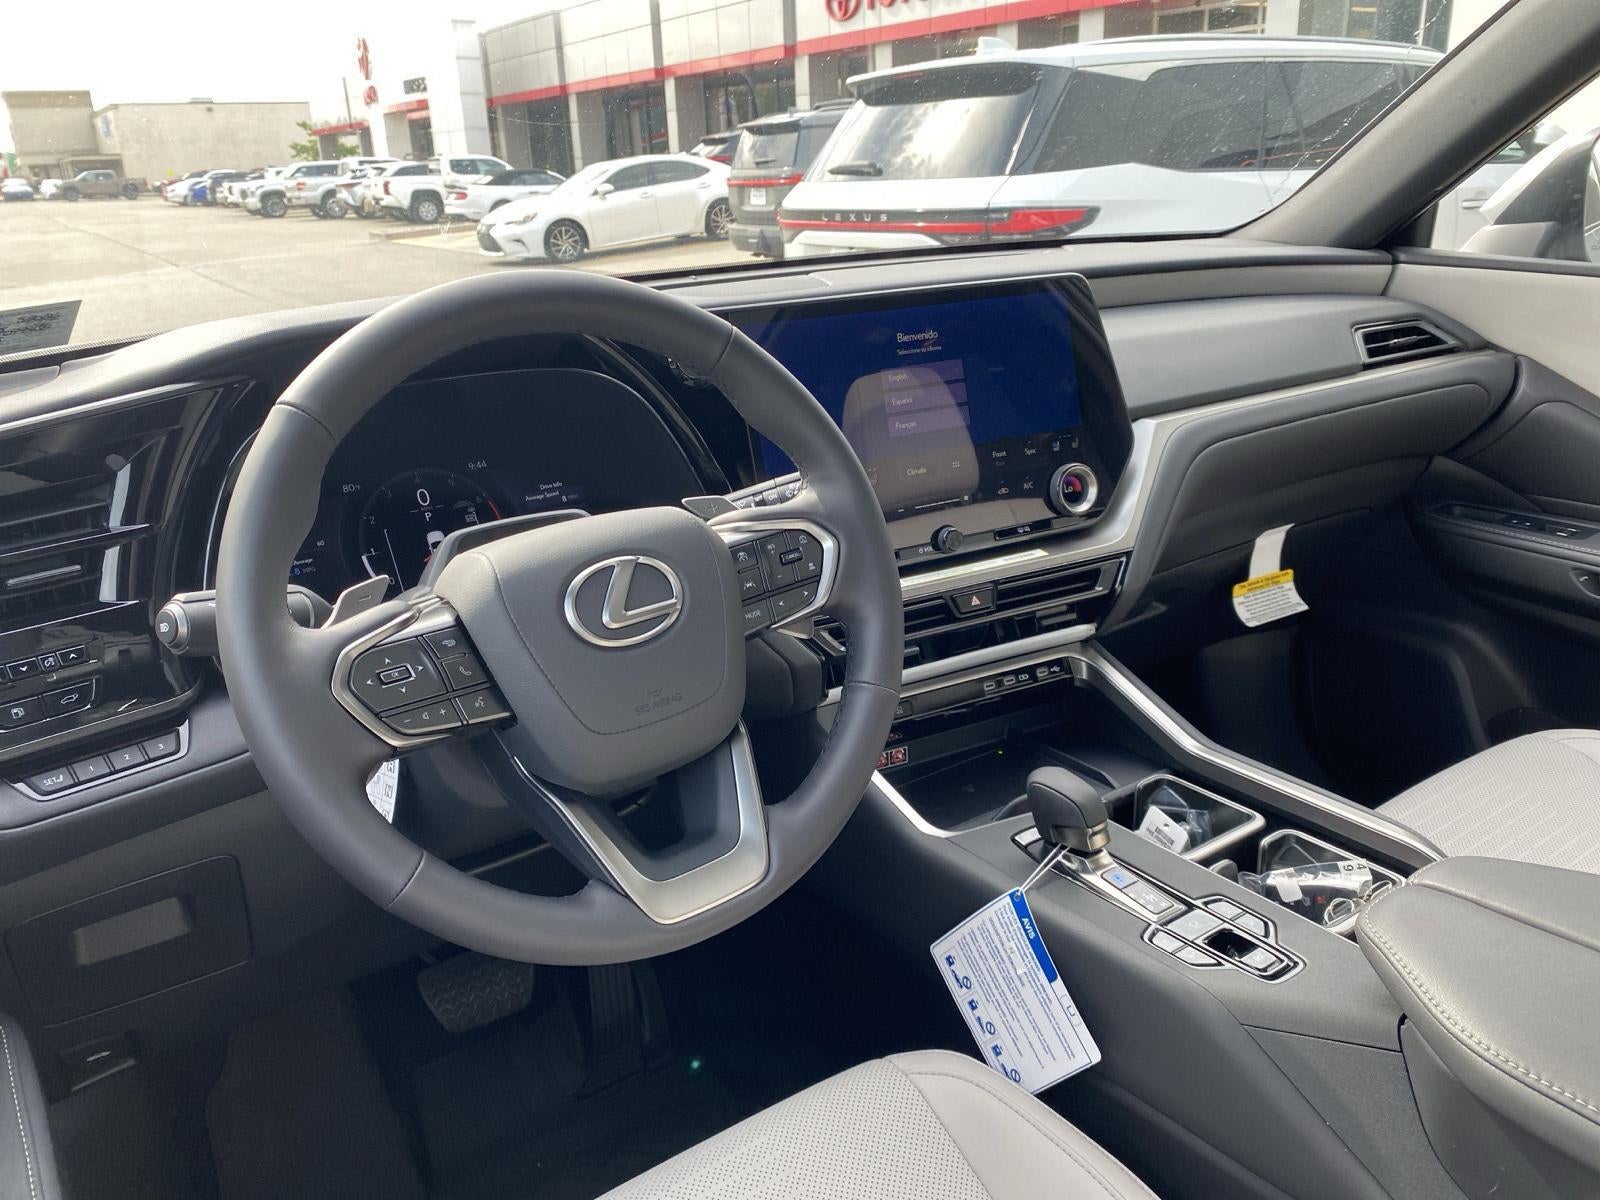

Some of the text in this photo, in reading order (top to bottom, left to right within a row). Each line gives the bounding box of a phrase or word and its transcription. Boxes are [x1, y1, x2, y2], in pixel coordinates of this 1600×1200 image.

[822, 213, 888, 221] LEXUS
[897, 330, 939, 343] Bienvenido
[1024, 448, 1037, 456] Sync
[468, 460, 487, 470] 9:44
[1023, 481, 1034, 490] A/C
[416, 488, 430, 506] 0
[424, 512, 432, 522] P
[44, 776, 57, 786] SET
[1022, 917, 1036, 939] AVIS
